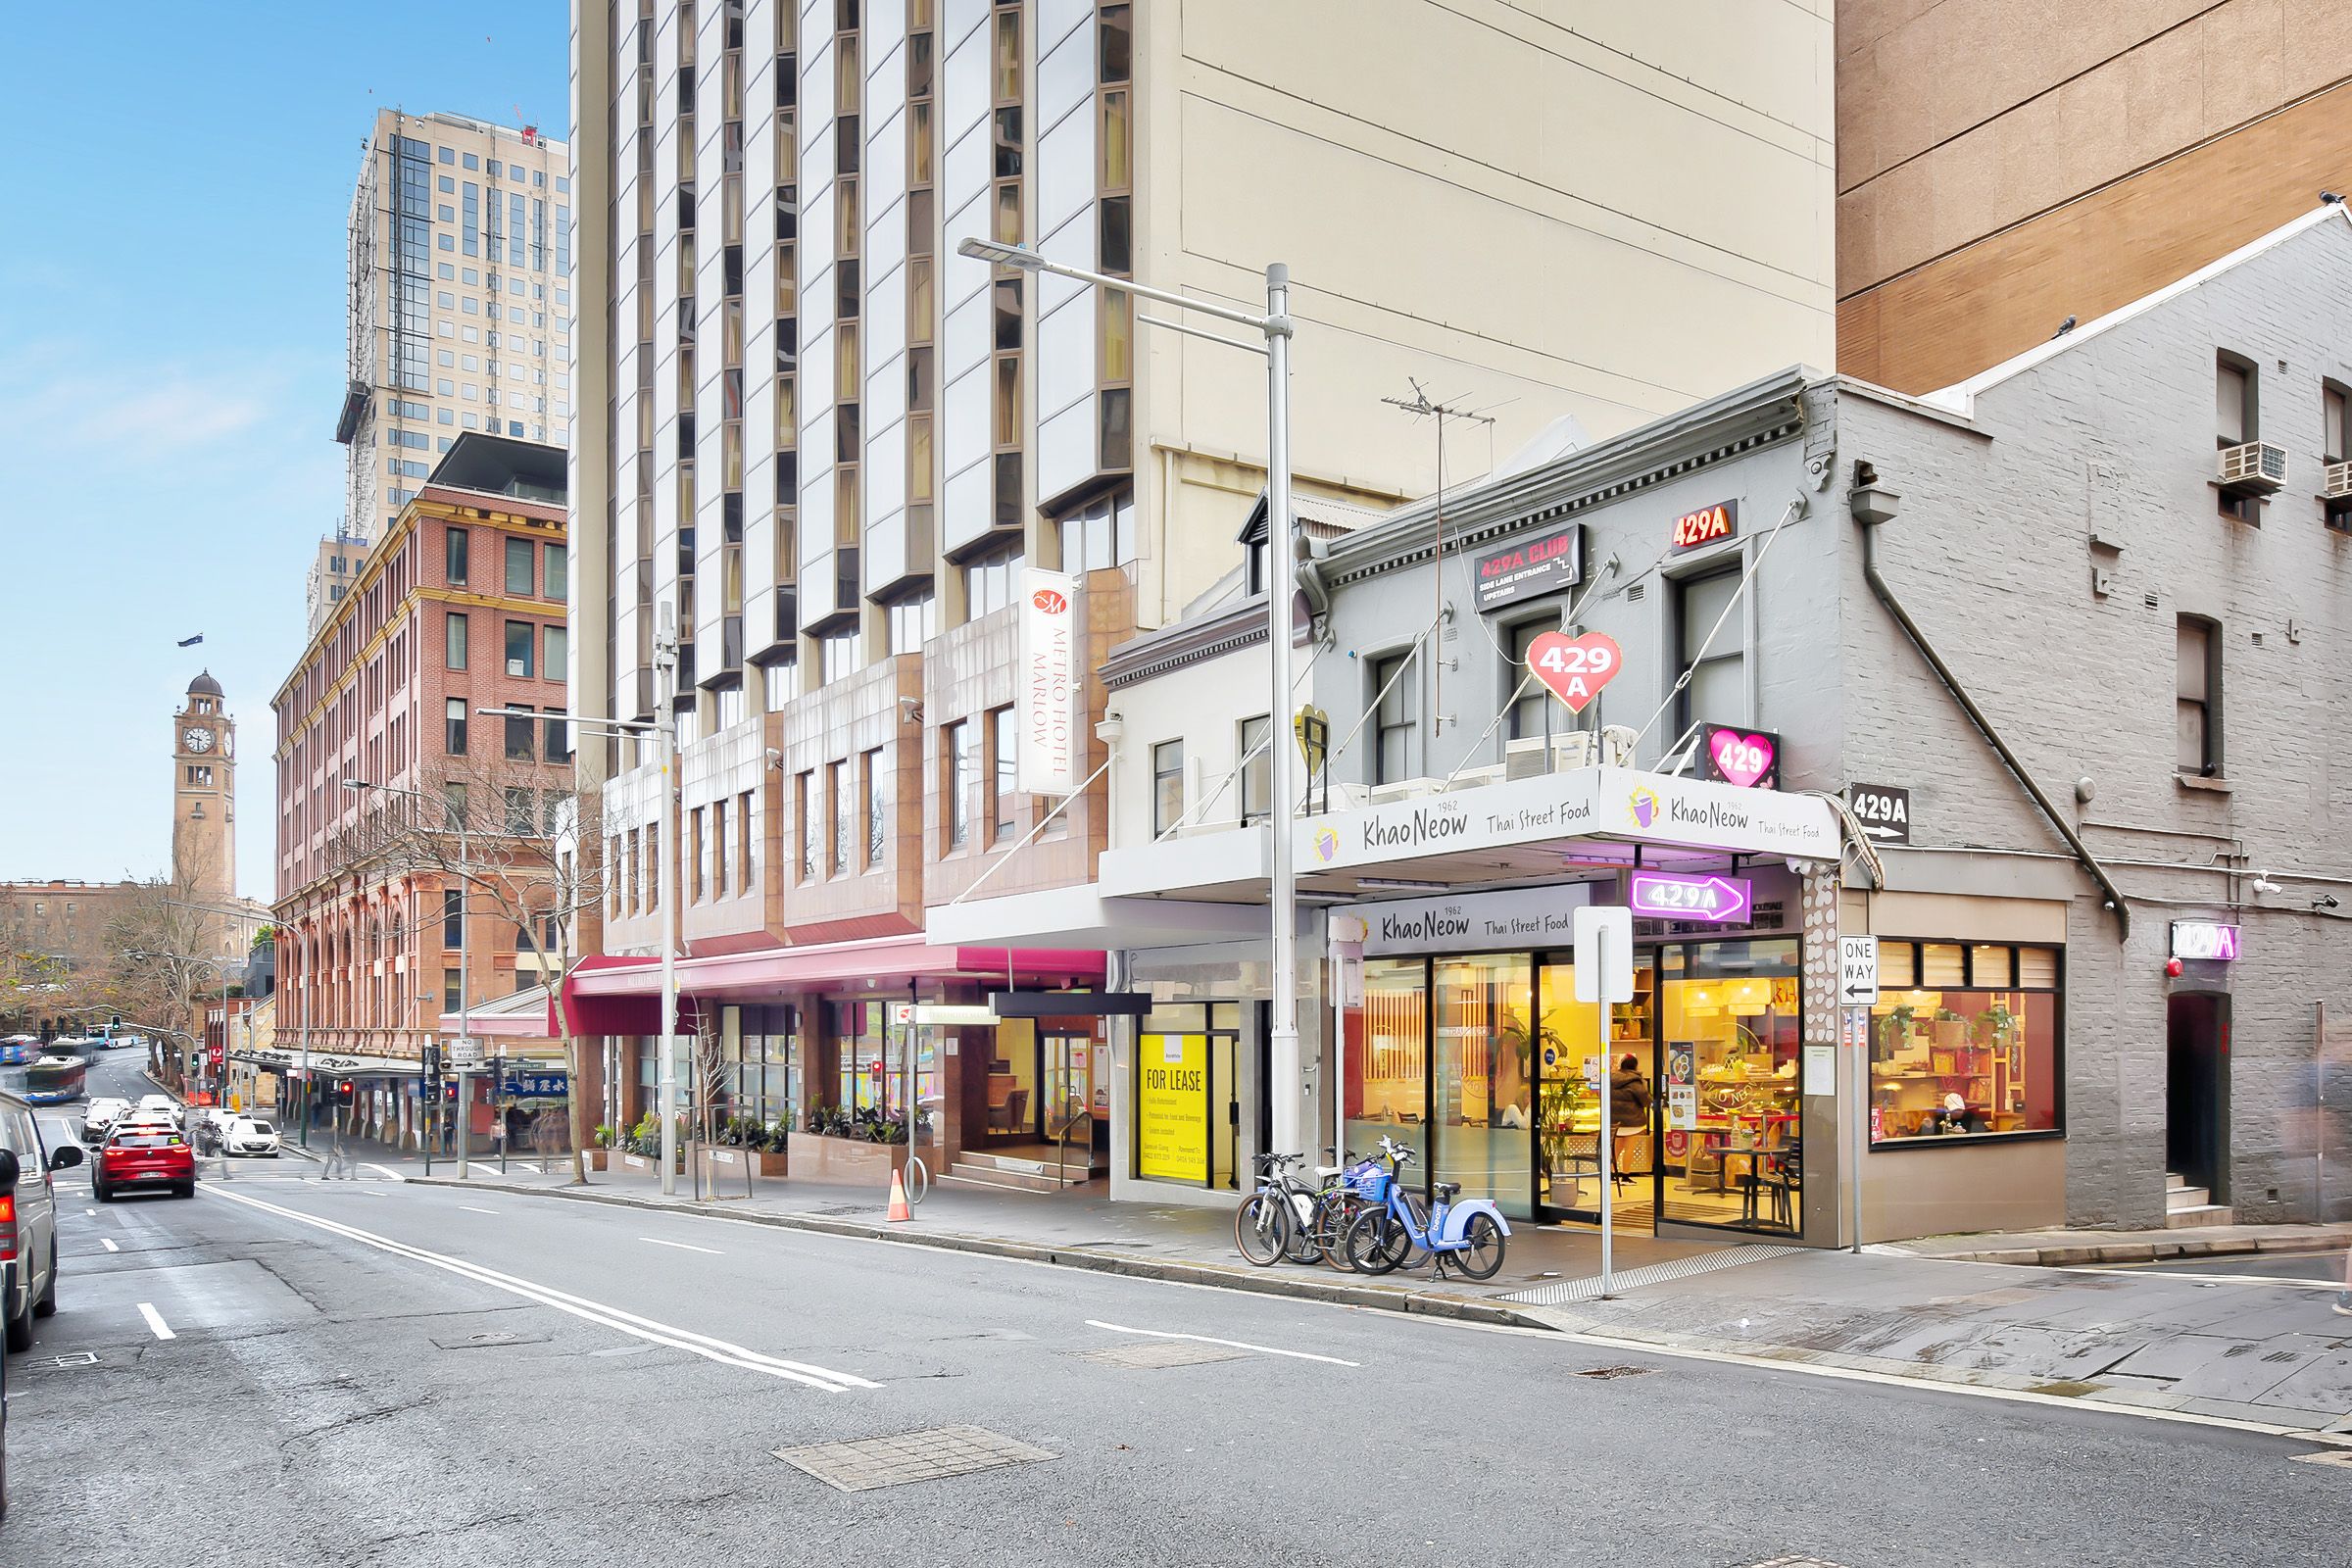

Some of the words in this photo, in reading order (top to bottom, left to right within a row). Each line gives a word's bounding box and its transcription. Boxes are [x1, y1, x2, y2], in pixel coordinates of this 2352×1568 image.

[1673, 506, 1729, 546] 429A
[1481, 552, 1524, 578] 429A
[1529, 535, 1569, 564] CLUB
[1479, 581, 1494, 591] SIDE
[1495, 575, 1513, 587] LANE
[1514, 564, 1551, 581] ENTRANCE
[1483, 586, 1515, 601] UPSTAIRS
[1053, 628, 1067, 703] METRO
[1540, 646, 1612, 673] 429
[1566, 676, 1589, 697] A
[1033, 653, 1048, 748] MARLOW
[1053, 710, 1067, 777] HOTEL
[1718, 743, 1763, 773] 429
[1438, 801, 1458, 813] 1962
[1487, 815, 1514, 834] Thai
[1519, 804, 1553, 831] Street
[1560, 798, 1591, 824] Food
[1853, 794, 1907, 823] 429A
[1758, 820, 1777, 835] Thai
[1779, 824, 1801, 839] Street
[1802, 825, 1820, 839] Food
[1648, 884, 1717, 909] 429A
[1445, 906, 1462, 916] 1962
[1485, 921, 1507, 936] Thai
[1510, 916, 1541, 935] Street
[1544, 913, 1569, 930] Food
[1845, 943, 1872, 957] ONE
[1844, 964, 1874, 979] WAY
[1147, 1069, 1166, 1090] FOR
[1170, 1069, 1201, 1092] LEASE
[1432, 1204, 1443, 1232] beam
